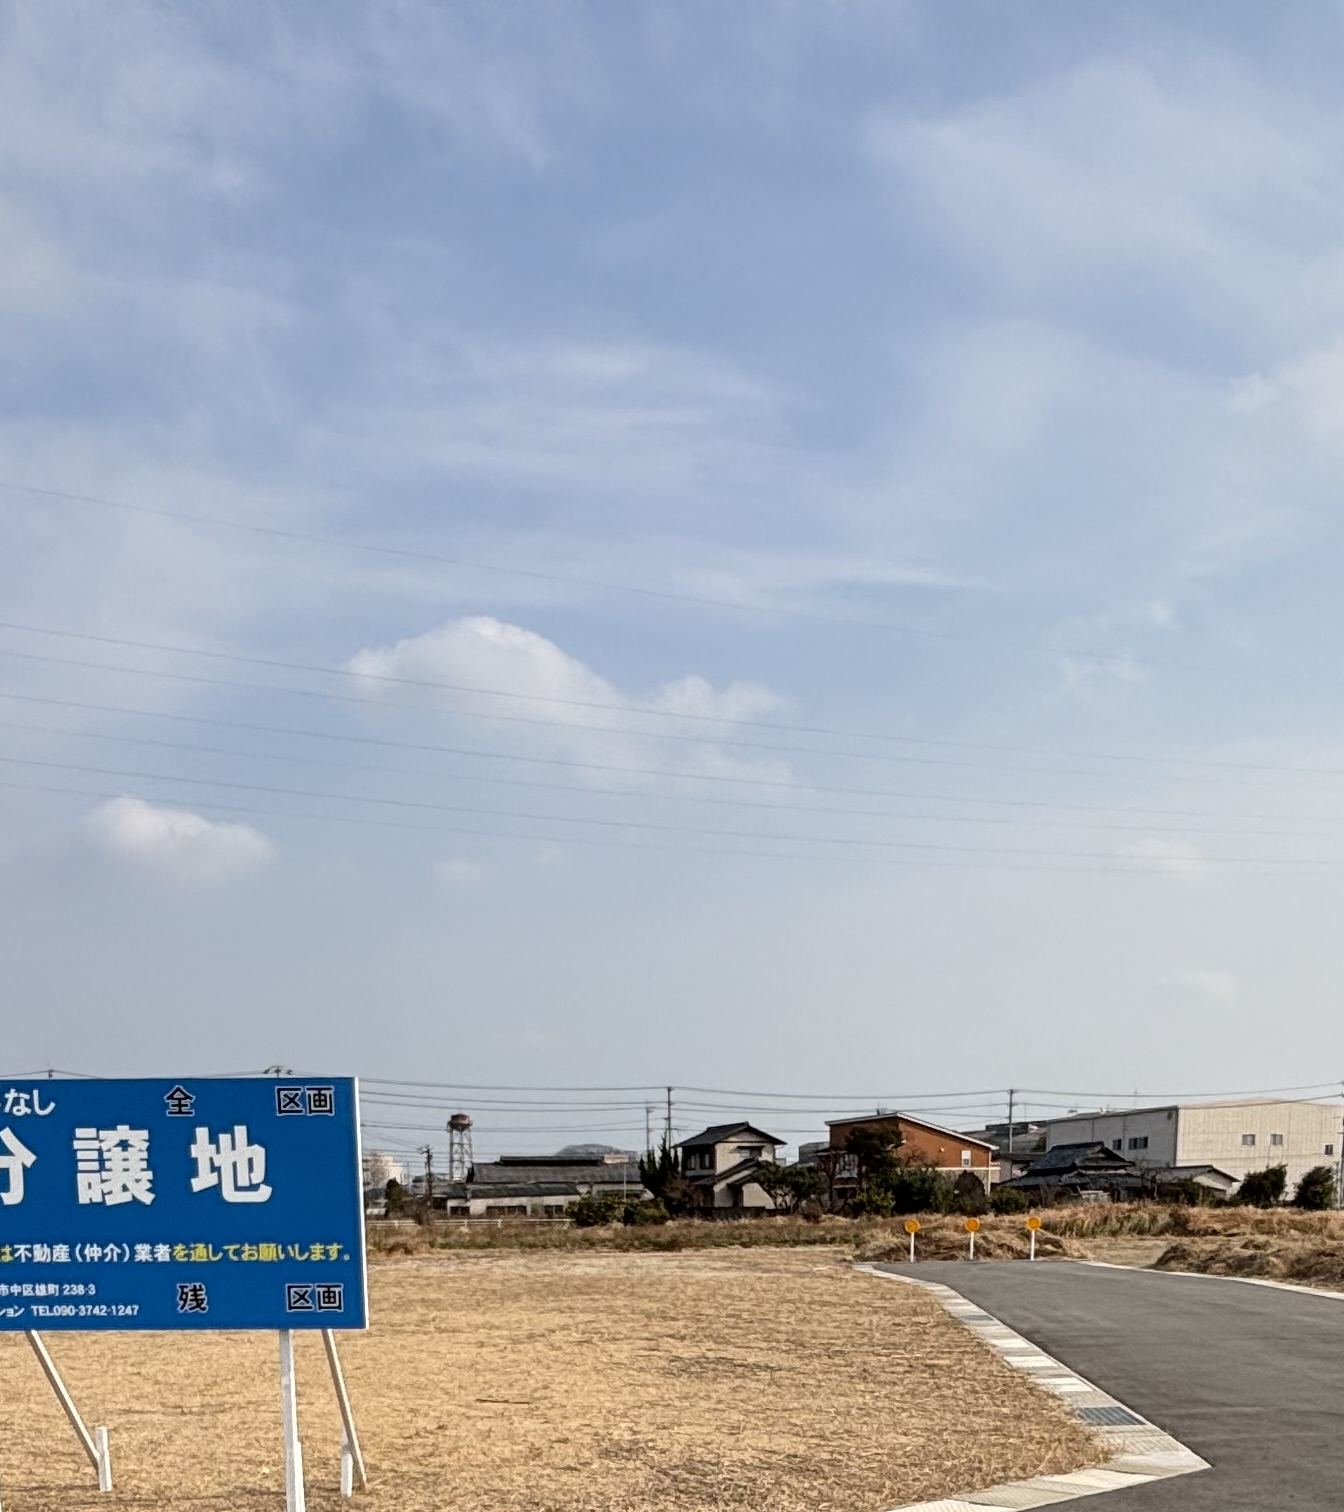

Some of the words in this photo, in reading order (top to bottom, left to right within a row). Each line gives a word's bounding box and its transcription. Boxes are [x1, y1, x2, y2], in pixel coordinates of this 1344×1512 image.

[164, 1085, 196, 1117] 全
[275, 1085, 335, 1117] 区画
[62, 1283, 96, 1296] 238-3
[176, 1282, 209, 1313] 残
[285, 1282, 344, 1313] 区画
